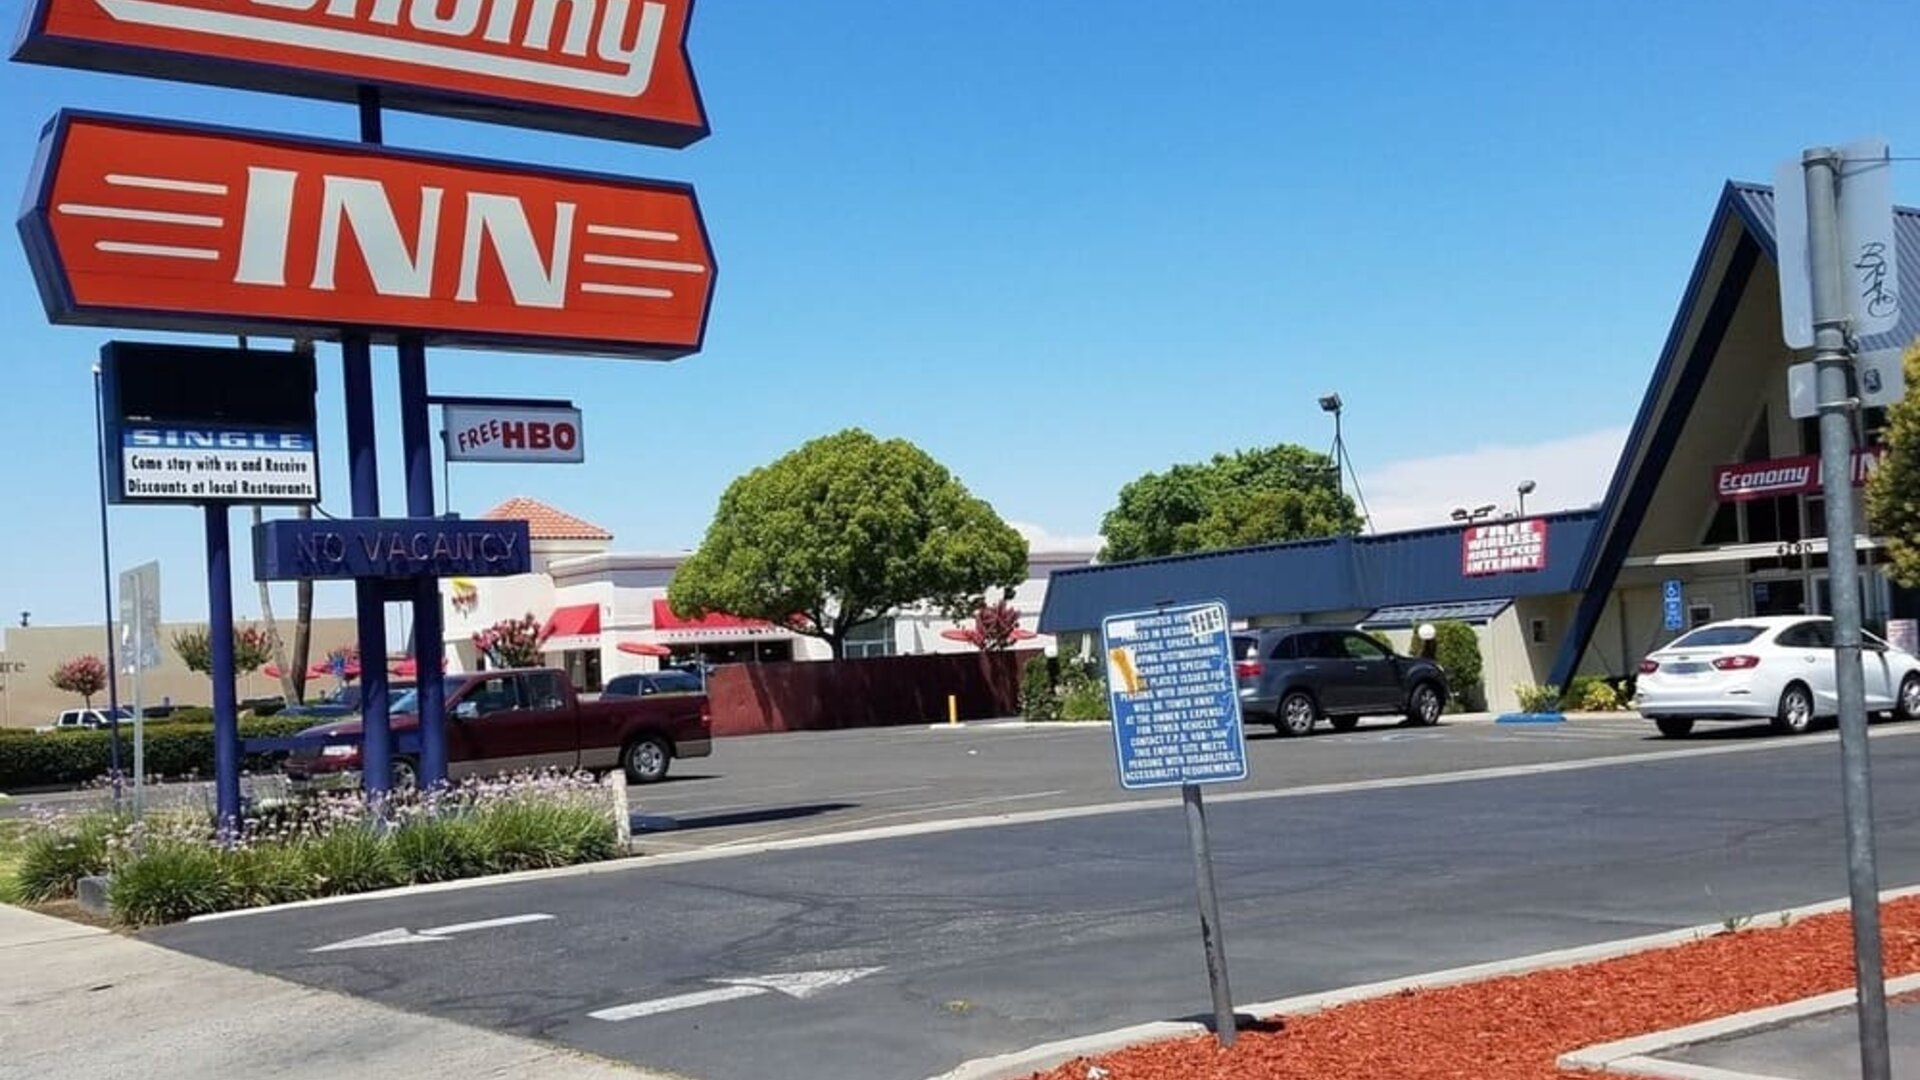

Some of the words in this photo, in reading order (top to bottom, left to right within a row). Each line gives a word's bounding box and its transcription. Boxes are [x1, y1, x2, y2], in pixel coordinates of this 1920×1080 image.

[234, 167, 576, 309] INN
[132, 429, 306, 449] SINGLE
[458, 419, 500, 453] FREE
[502, 420, 576, 451] HBO
[132, 455, 162, 470] Come
[167, 458, 191, 473] stay
[197, 456, 221, 470] with
[225, 461, 237, 472] us
[242, 458, 262, 473] and
[265, 458, 307, 473] Receive
[128, 479, 187, 493] Discounts
[192, 480, 204, 493] at
[209, 479, 237, 494] local
[242, 480, 312, 495] Restaurants
[1719, 466, 1810, 495] Economy
[1476, 521, 1535, 538] FREE
[297, 531, 346, 562] NO
[359, 531, 517, 561] VACANCY
[1468, 532, 1541, 551] WIRELESS
[1501, 543, 1541, 557] SPEED
[1467, 556, 1537, 573] INTERNET
